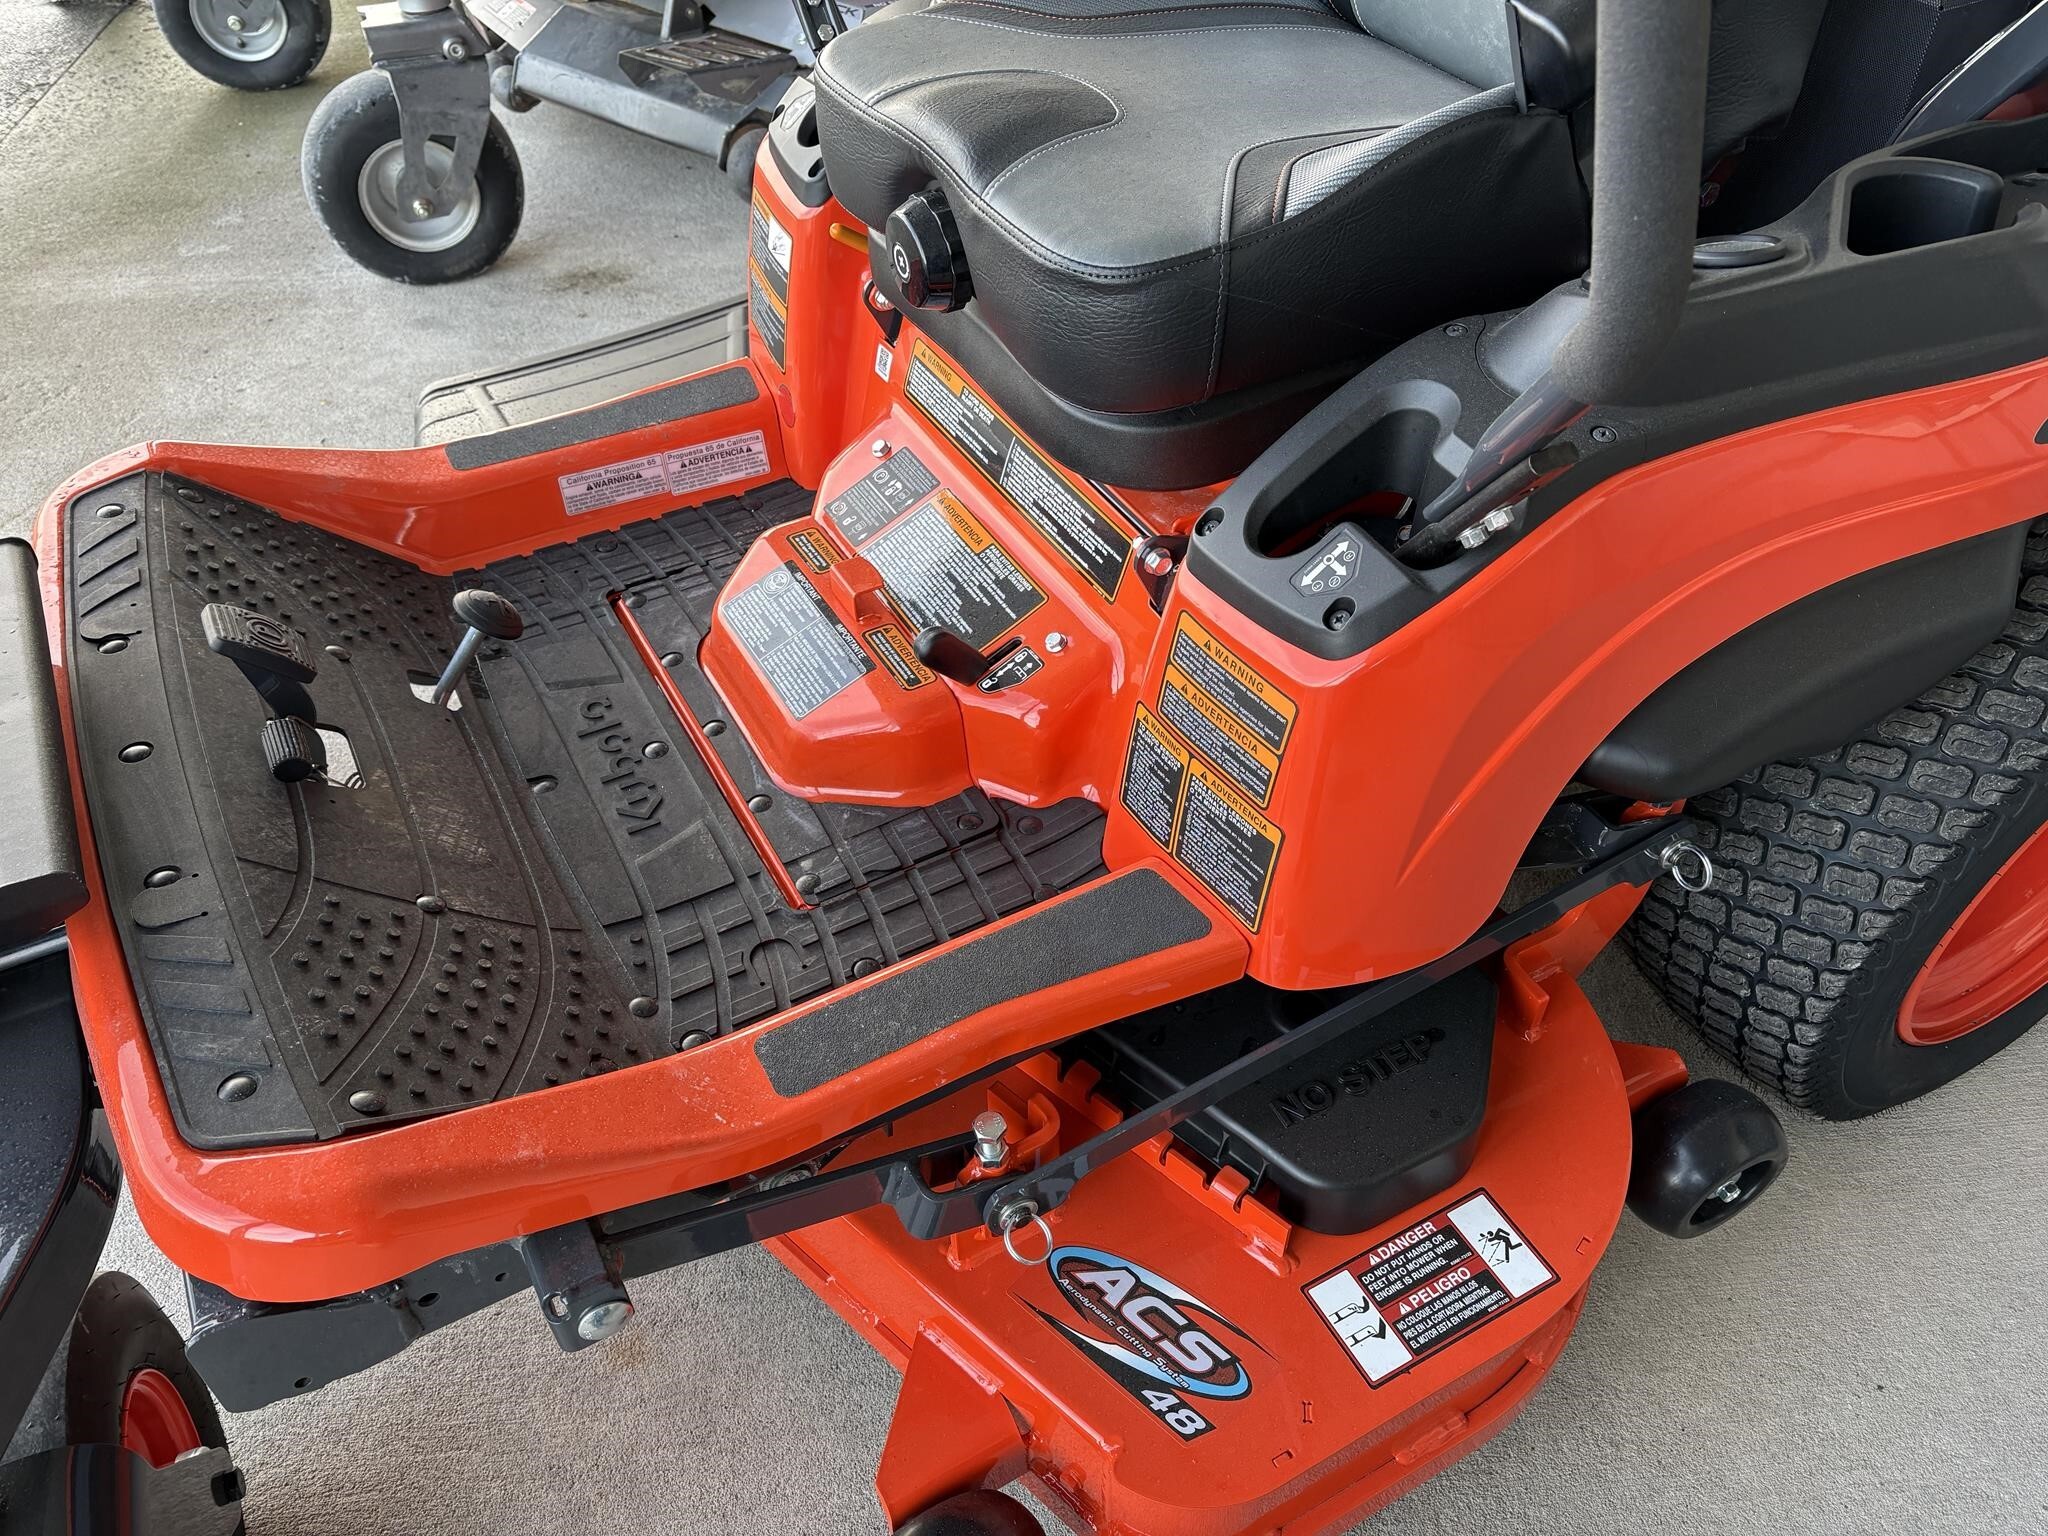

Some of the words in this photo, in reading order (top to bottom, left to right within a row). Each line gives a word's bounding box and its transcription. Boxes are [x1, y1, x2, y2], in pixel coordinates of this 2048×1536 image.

[927, 355, 952, 382] WARNING
[666, 448, 703, 461] Propuesta
[704, 444, 714, 452] 65
[726, 434, 760, 447] California
[688, 446, 744, 466] ADVERTENCIA
[566, 471, 602, 485] California
[603, 461, 645, 476] Proposition
[592, 472, 635, 488] WARNING
[943, 504, 983, 546] ADVERTENCIA
[793, 571, 820, 600] IMPORTANT
[834, 623, 866, 659] IMPORTANTE
[888, 634, 931, 681] ADVERTENCIA
[1214, 646, 1264, 693] WARNING
[1150, 720, 1181, 756] WARNING
[1191, 692, 1257, 754] ADVERTENCIA
[576, 696, 664, 836] Kubota
[1190, 780, 1227, 816] PERSONALES
[1228, 814, 1251, 837] GRAVES
[1191, 775, 1207, 792] PARA
[1207, 788, 1227, 809] EVITAR
[1228, 807, 1256, 835] LESIONES
[1195, 791, 1202, 801] LA
[1203, 798, 1226, 822] MUERTE
[1210, 779, 1267, 832] ADVERTENCIA
[1268, 1079, 1334, 1129] NO
[1337, 1032, 1432, 1097] STEP
[1361, 1272, 1375, 1284] DO
[1373, 1263, 1391, 1277] NOT
[1389, 1254, 1406, 1268] PUT
[1405, 1240, 1433, 1259] HANDS
[1431, 1233, 1445, 1244] OR
[1377, 1221, 1436, 1259] DANGER
[1367, 1276, 1388, 1292] FEET
[1386, 1266, 1407, 1281] INTO
[1405, 1250, 1436, 1271] MOWER
[1433, 1238, 1458, 1254] WHEN
[1374, 1280, 1404, 1301] ENGINE
[1402, 1276, 1412, 1284] IS
[1410, 1256, 1448, 1280] RUNNING.
[1408, 1267, 1470, 1307] PELIGRO
[1070, 1269, 1231, 1374] ACS
[1395, 1320, 1407, 1330] NO
[1404, 1305, 1432, 1325] COLOQUE
[1430, 1300, 1443, 1310] LAS
[1440, 1289, 1462, 1305] MANOS
[1458, 1285, 1468, 1294] NI
[1464, 1279, 1478, 1290] LOS
[1402, 1327, 1418, 1340] PIES
[1414, 1322, 1426, 1332] EN
[1422, 1318, 1433, 1328] LA
[1430, 1300, 1465, 1323] CORTADORA
[1462, 1285, 1490, 1305] MIENTRAS
[1409, 1339, 1420, 1348] EL
[1416, 1327, 1439, 1344] MOTOR
[1435, 1318, 1453, 1333] ESTÁ
[1449, 1315, 1461, 1325] EN
[1457, 1290, 1505, 1320] FUNCIONAMIENTO.
[1059, 1278, 1116, 1327] Aerodynamic
[1116, 1326, 1153, 1358] Cutting
[1153, 1358, 1189, 1389] System
[1140, 1389, 1207, 1435] 48
